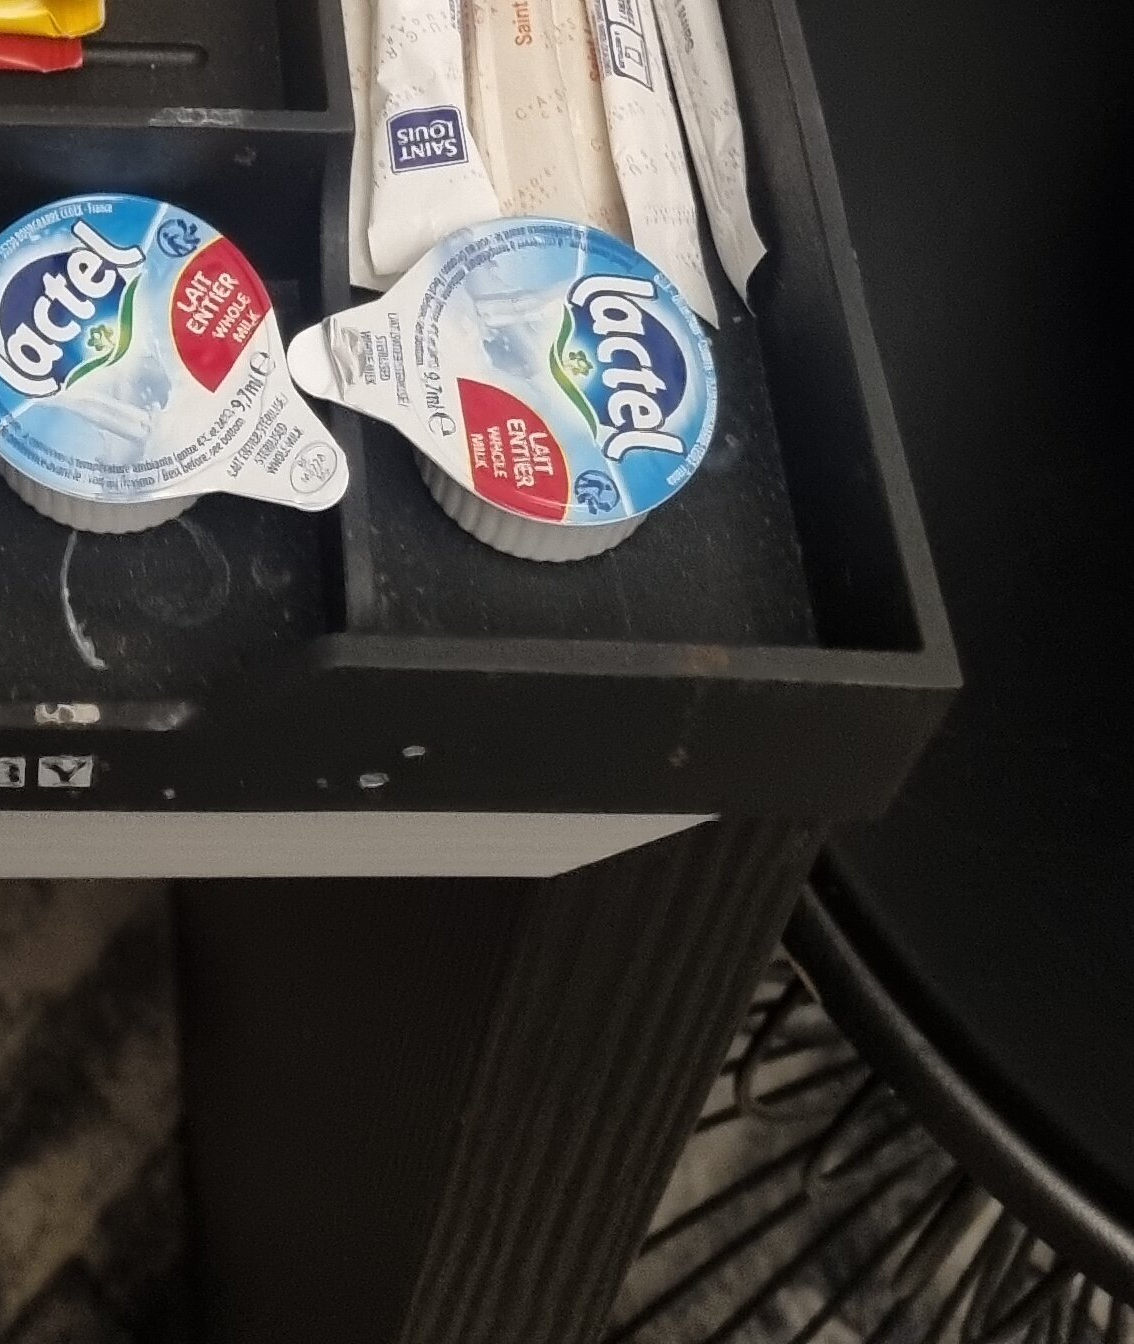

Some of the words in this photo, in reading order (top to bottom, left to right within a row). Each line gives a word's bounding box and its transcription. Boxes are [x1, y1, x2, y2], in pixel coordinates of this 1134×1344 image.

[396, 119, 455, 145] LOUIS
[399, 138, 458, 162] SAINT
[177, 270, 212, 313] LAIT
[186, 272, 240, 335] ENTIER
[212, 291, 251, 340] WHOLE
[232, 308, 261, 343] MILK
[567, 273, 687, 462] lactel
[470, 433, 489, 469] MILK
[506, 418, 535, 488] ENTIER
[529, 432, 553, 476] LAIT
